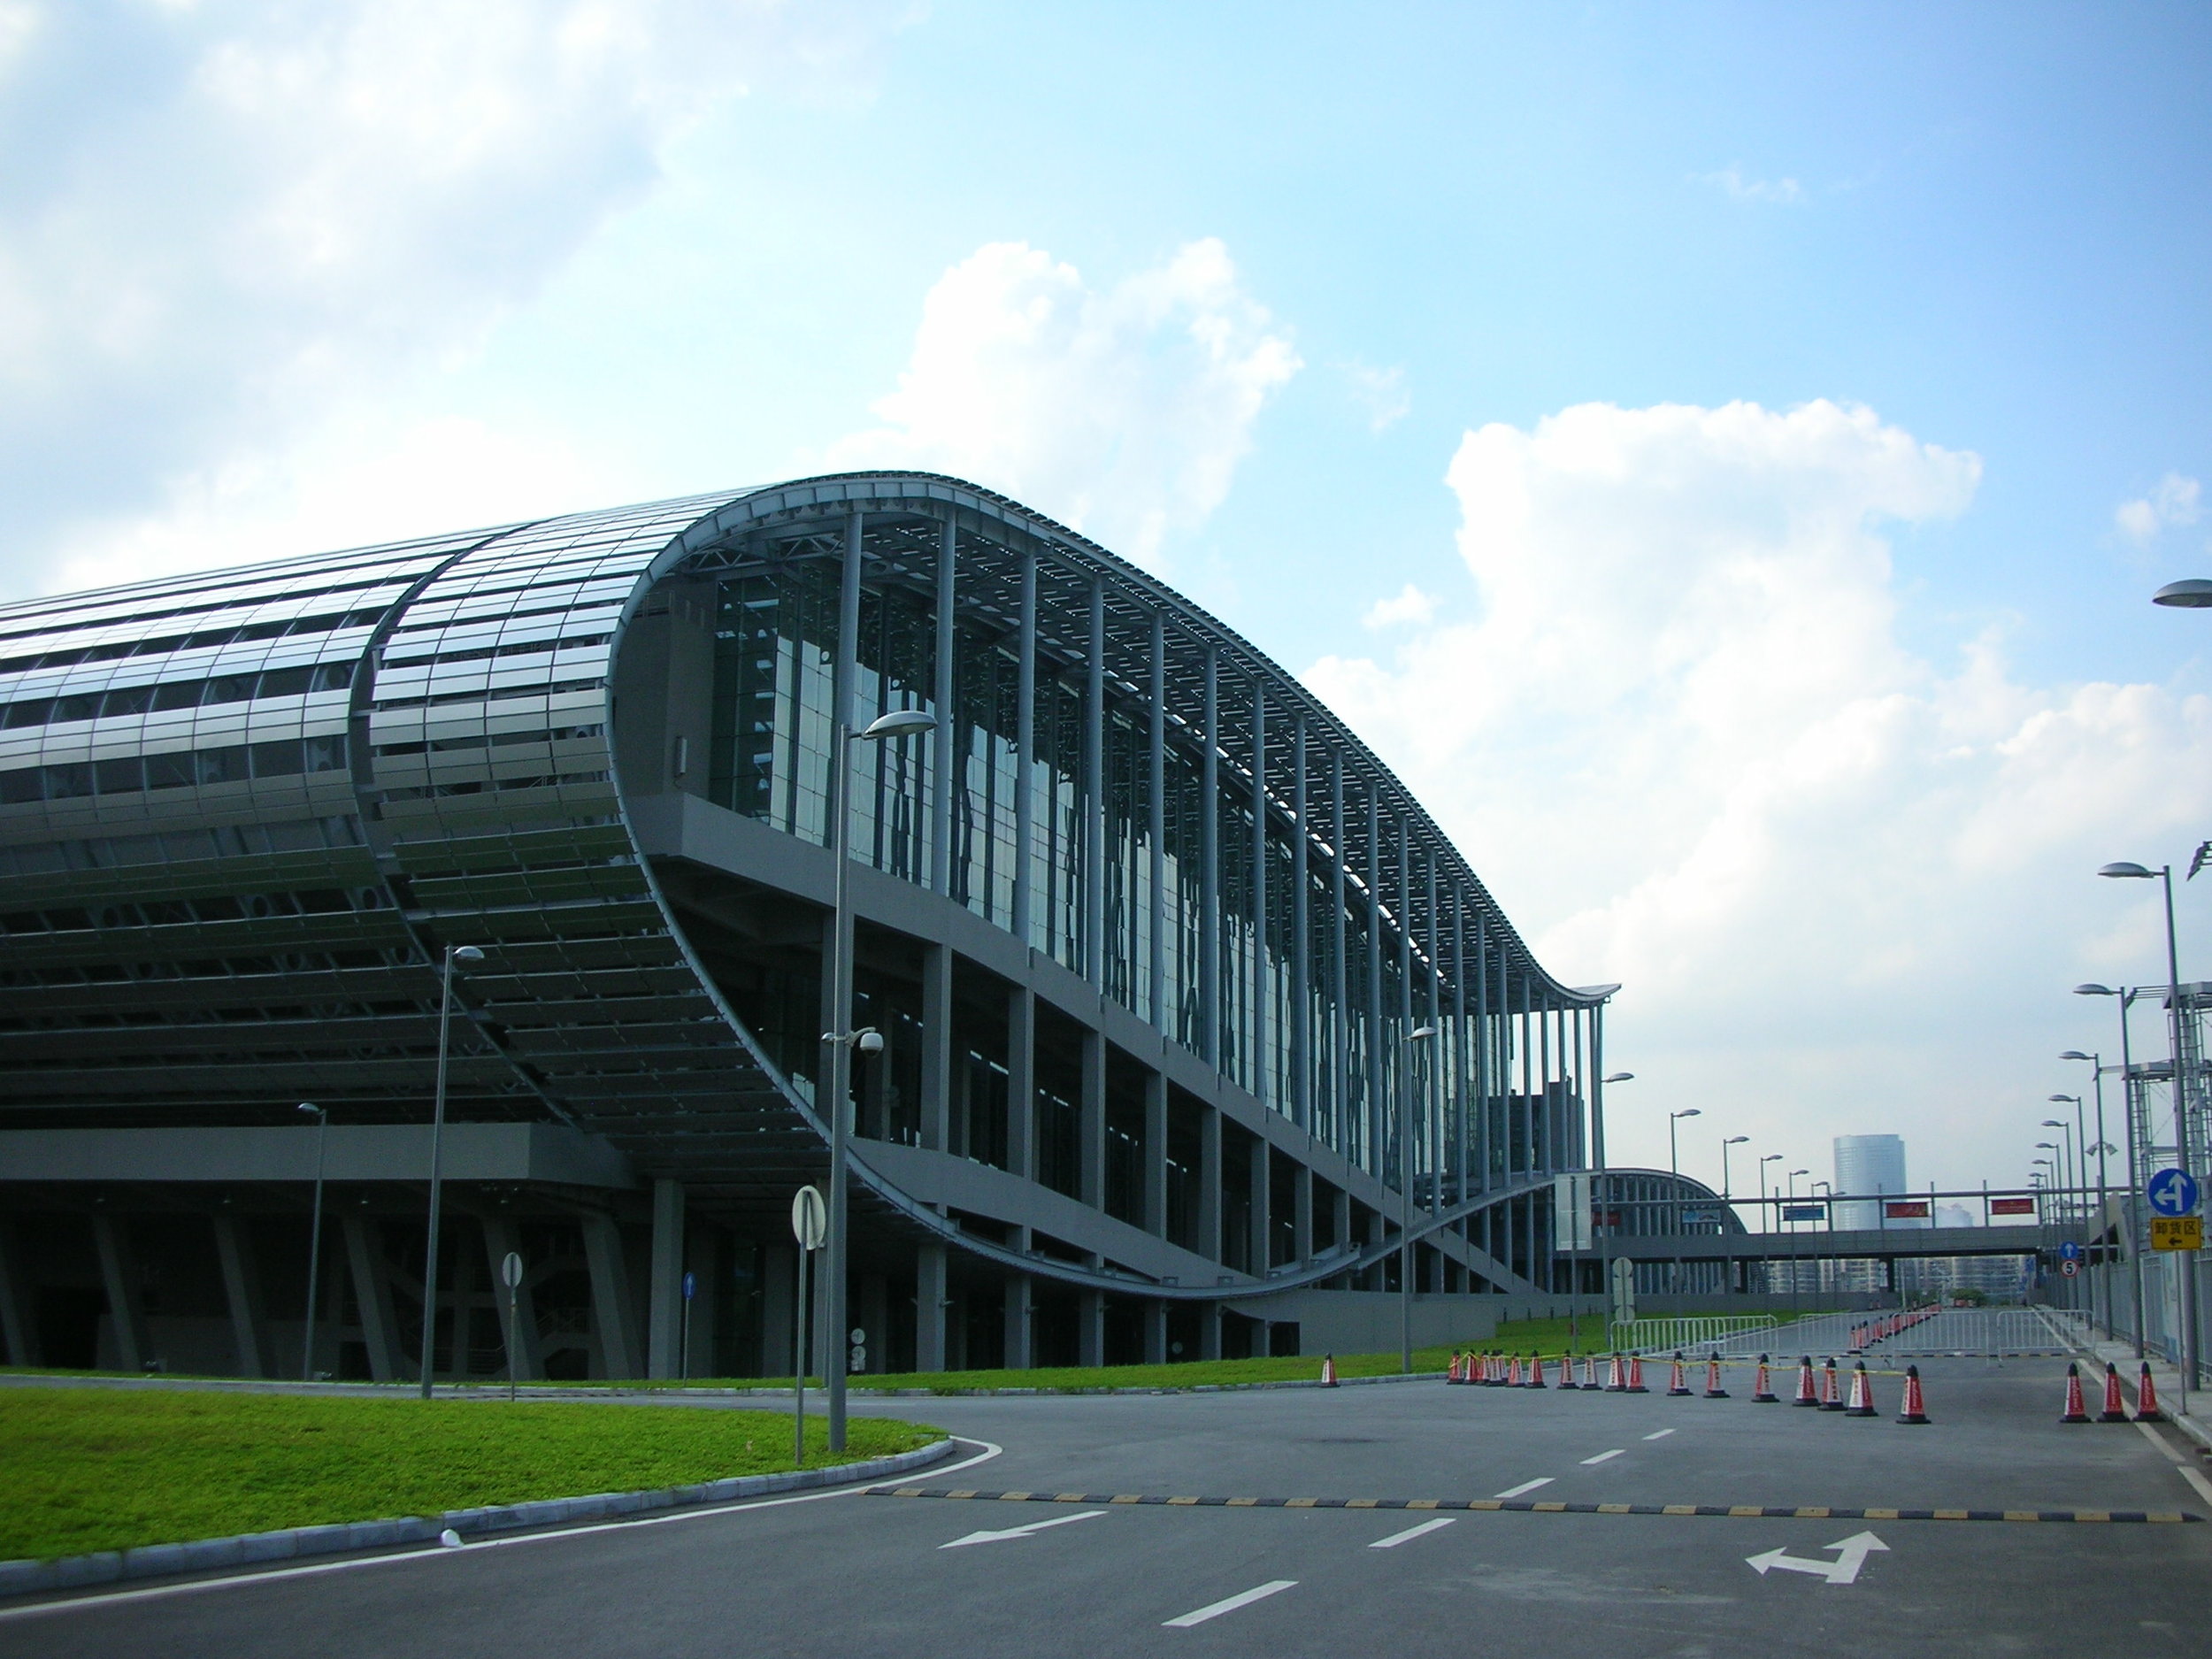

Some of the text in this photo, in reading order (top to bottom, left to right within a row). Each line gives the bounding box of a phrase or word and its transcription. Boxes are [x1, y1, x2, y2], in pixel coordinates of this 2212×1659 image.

[2155, 1221, 2196, 1235] 卸货区
[2066, 1263, 2073, 1274] 5
